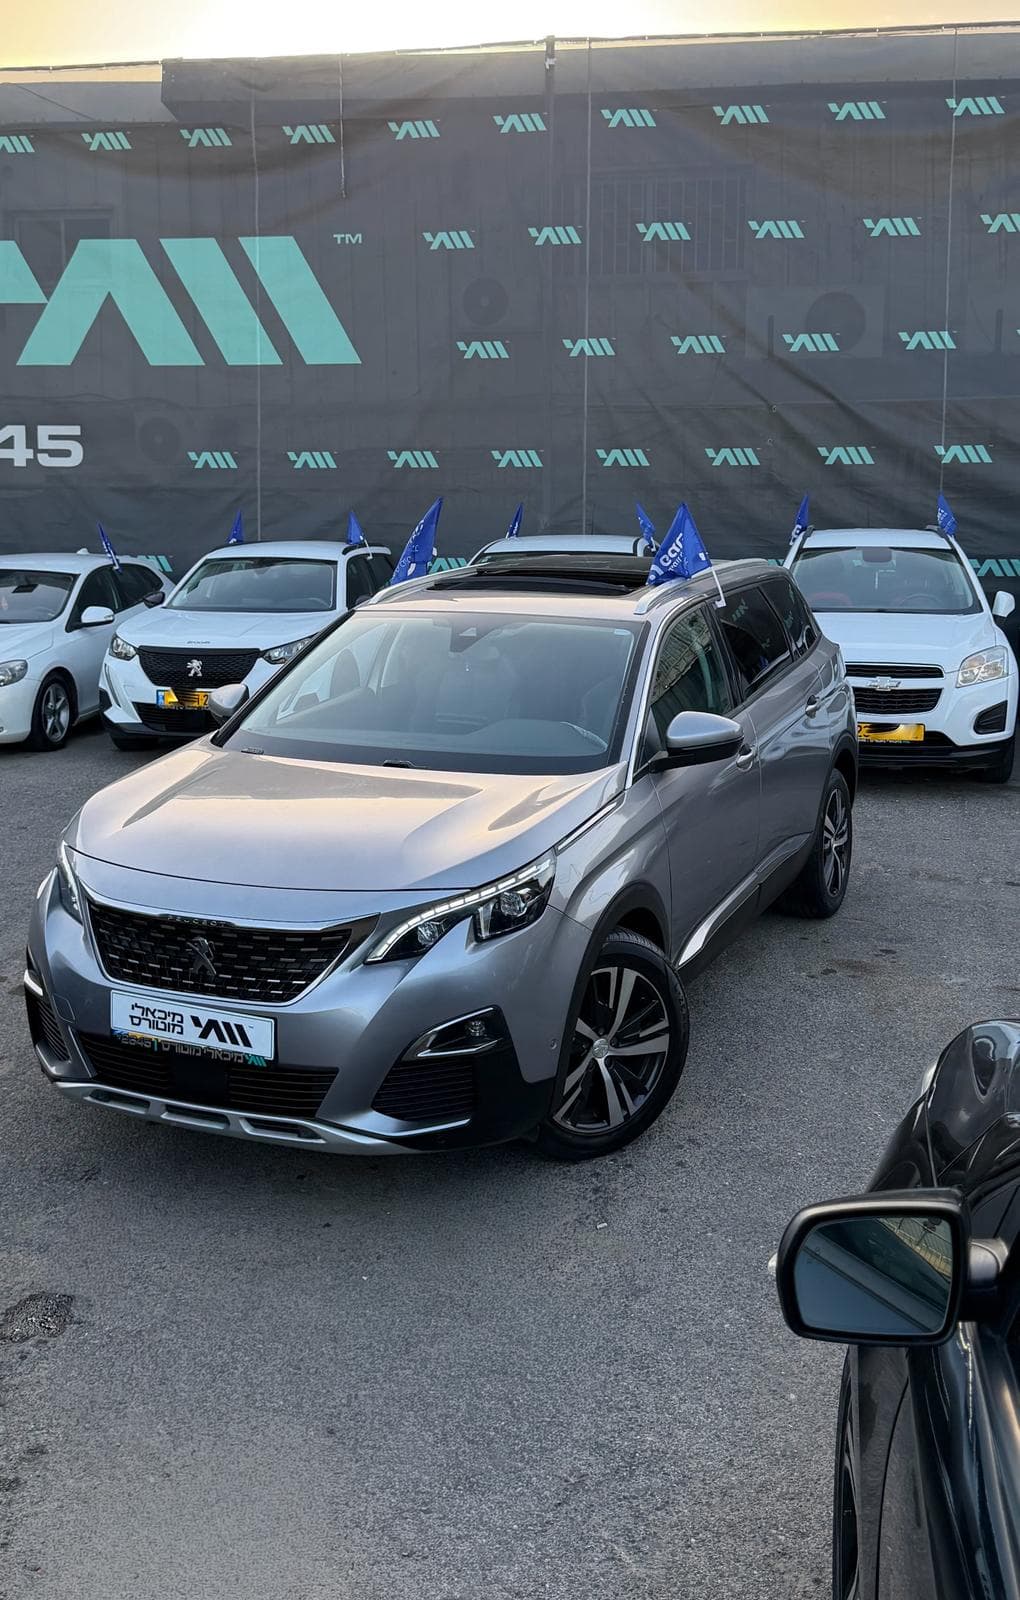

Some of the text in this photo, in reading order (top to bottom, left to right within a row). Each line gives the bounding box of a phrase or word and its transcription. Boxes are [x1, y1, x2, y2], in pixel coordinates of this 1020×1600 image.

[333, 233, 363, 244] TM
[0, 424, 84, 468] 45
[131, 1002, 184, 1024] מיכאלי
[128, 1014, 184, 1035] מוטורס
